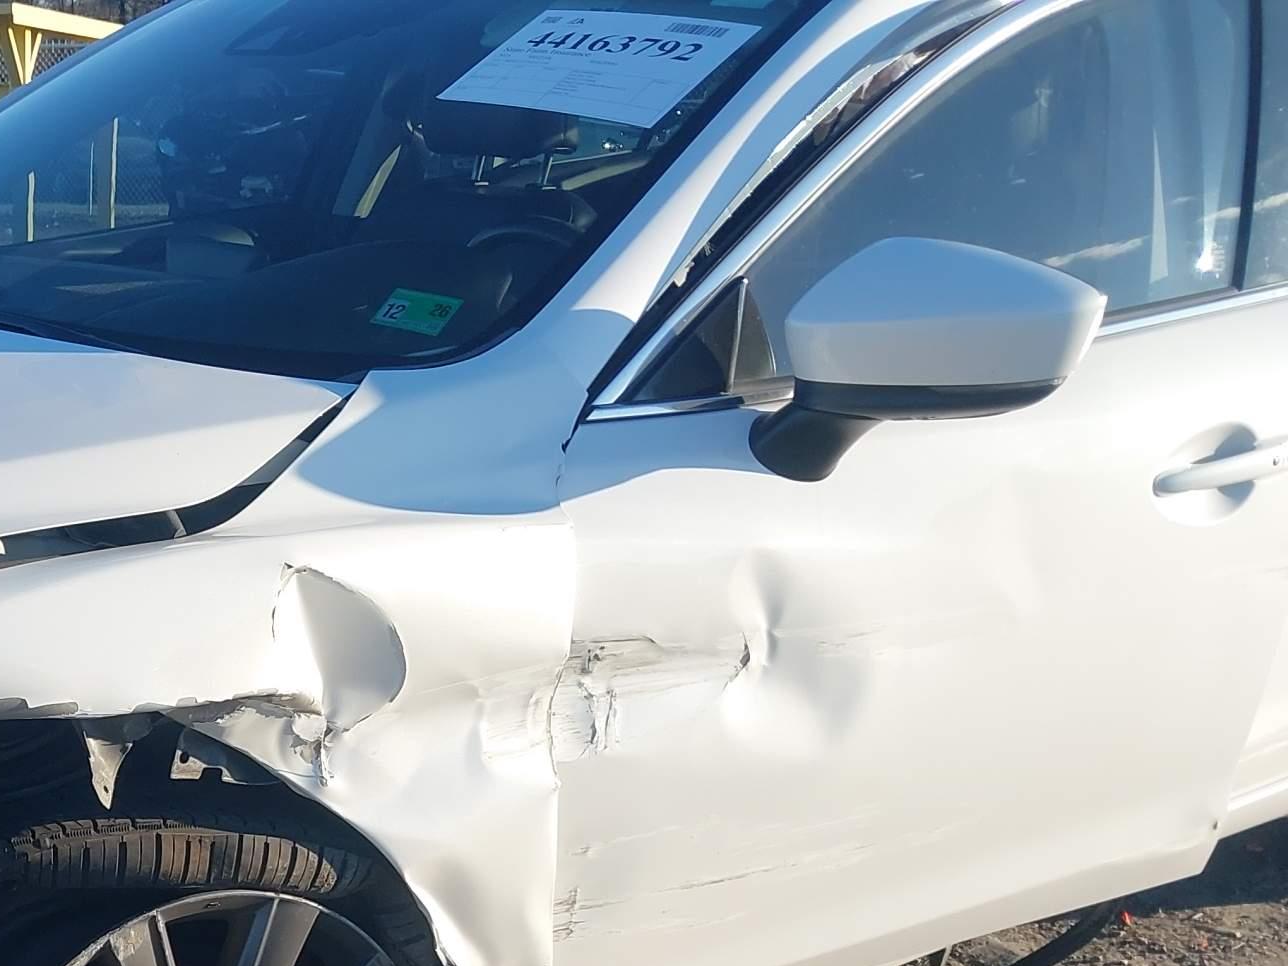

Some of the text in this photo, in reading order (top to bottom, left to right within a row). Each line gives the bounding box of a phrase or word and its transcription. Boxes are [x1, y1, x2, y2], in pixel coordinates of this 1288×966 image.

[527, 31, 703, 63] 44163792
[382, 303, 453, 320] 12 26
